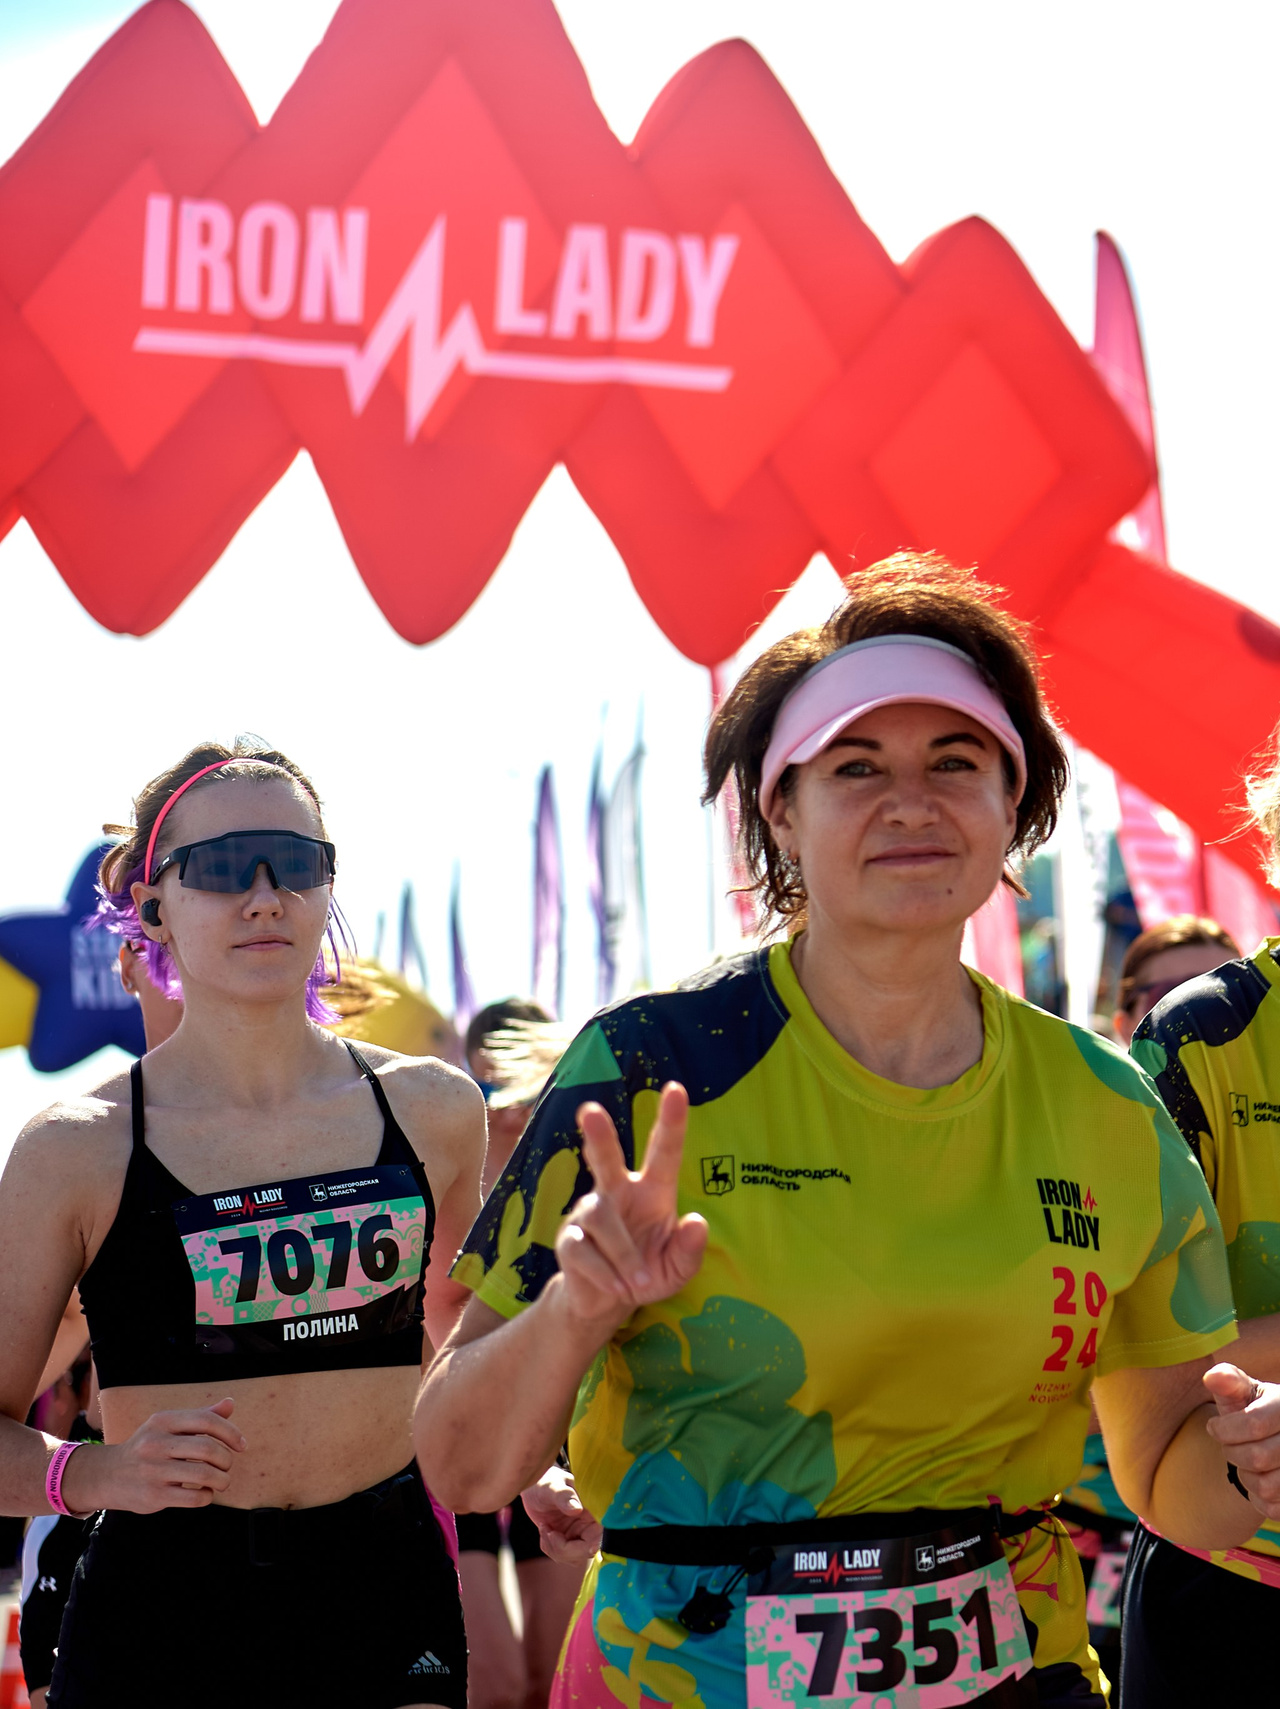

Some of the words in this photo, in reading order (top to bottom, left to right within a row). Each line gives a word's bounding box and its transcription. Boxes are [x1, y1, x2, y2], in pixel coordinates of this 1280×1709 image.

[140, 193, 369, 325] IRON
[495, 217, 741, 349] LADY
[213, 1194, 243, 1212] IRON
[253, 1187, 283, 1205] LADY
[327, 1178, 380, 1191] НИЖЕГОРОДСКАЯ
[329, 1188, 357, 1197] ОБЛАСТЬ
[741, 1175, 801, 1191] ОБЛАСТЬ
[1036, 1178, 1083, 1211] IRON
[1043, 1207, 1100, 1252] LADY
[218, 1214, 400, 1303] 7076
[1052, 1266, 1107, 1318] 20
[283, 1313, 359, 1341] ПОЛИНА
[1042, 1325, 1099, 1372] 24
[50, 1449, 67, 1492] NOVGOROD
[793, 1551, 828, 1571] IRON
[843, 1548, 881, 1570] LADY
[795, 1585, 998, 1697] 7351
